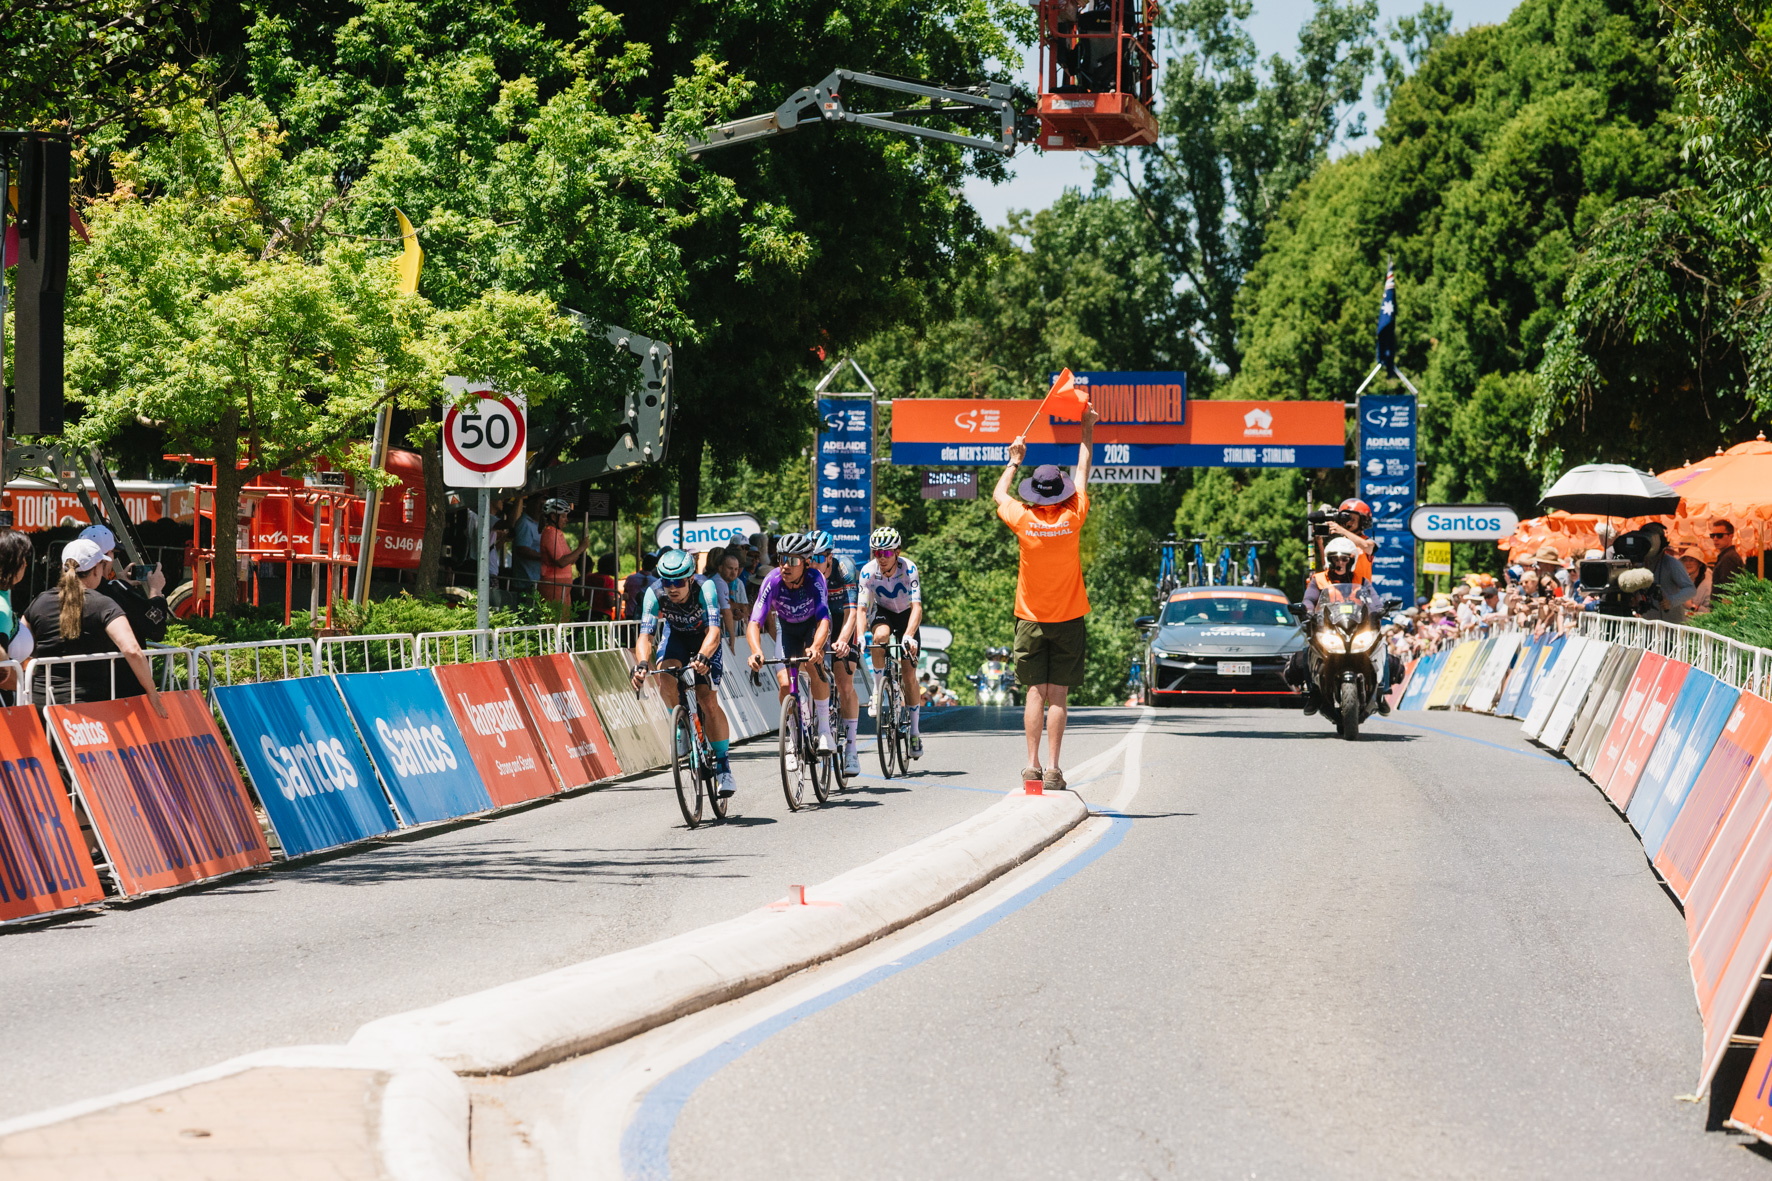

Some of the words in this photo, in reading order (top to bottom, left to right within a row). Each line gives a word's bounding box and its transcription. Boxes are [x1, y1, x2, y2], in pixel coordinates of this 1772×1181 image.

[1052, 374, 1089, 385] Stos
[1091, 384, 1135, 422] DOWN
[1136, 384, 1182, 422] UNDER
[460, 414, 510, 450] 50
[822, 441, 867, 450] ADELAIDE
[1365, 437, 1410, 447] ADELAIDE
[959, 446, 981, 461] MEN'S
[982, 446, 1003, 461] STAGE
[1104, 444, 1130, 464] 2026
[1223, 448, 1256, 463] STIRLING
[1262, 448, 1296, 463] STIRLING
[1091, 467, 1156, 481] ARMIN
[822, 486, 866, 499] Santos
[1365, 483, 1410, 495] Santos
[16, 496, 58, 527] TOUR
[1427, 514, 1502, 531] Santos
[832, 534, 860, 542] ARMIN
[1024, 528, 1073, 538] MARSHAL
[384, 535, 415, 551] SJ46
[1426, 556, 1450, 564] CLEAR
[1427, 549, 1451, 557] KEEP
[934, 662, 948, 674] 25
[529, 677, 587, 735] Vanguard
[457, 687, 526, 749] Vanguard
[62, 717, 109, 747] Santos
[376, 716, 458, 778] Santos
[260, 729, 359, 801] Santos
